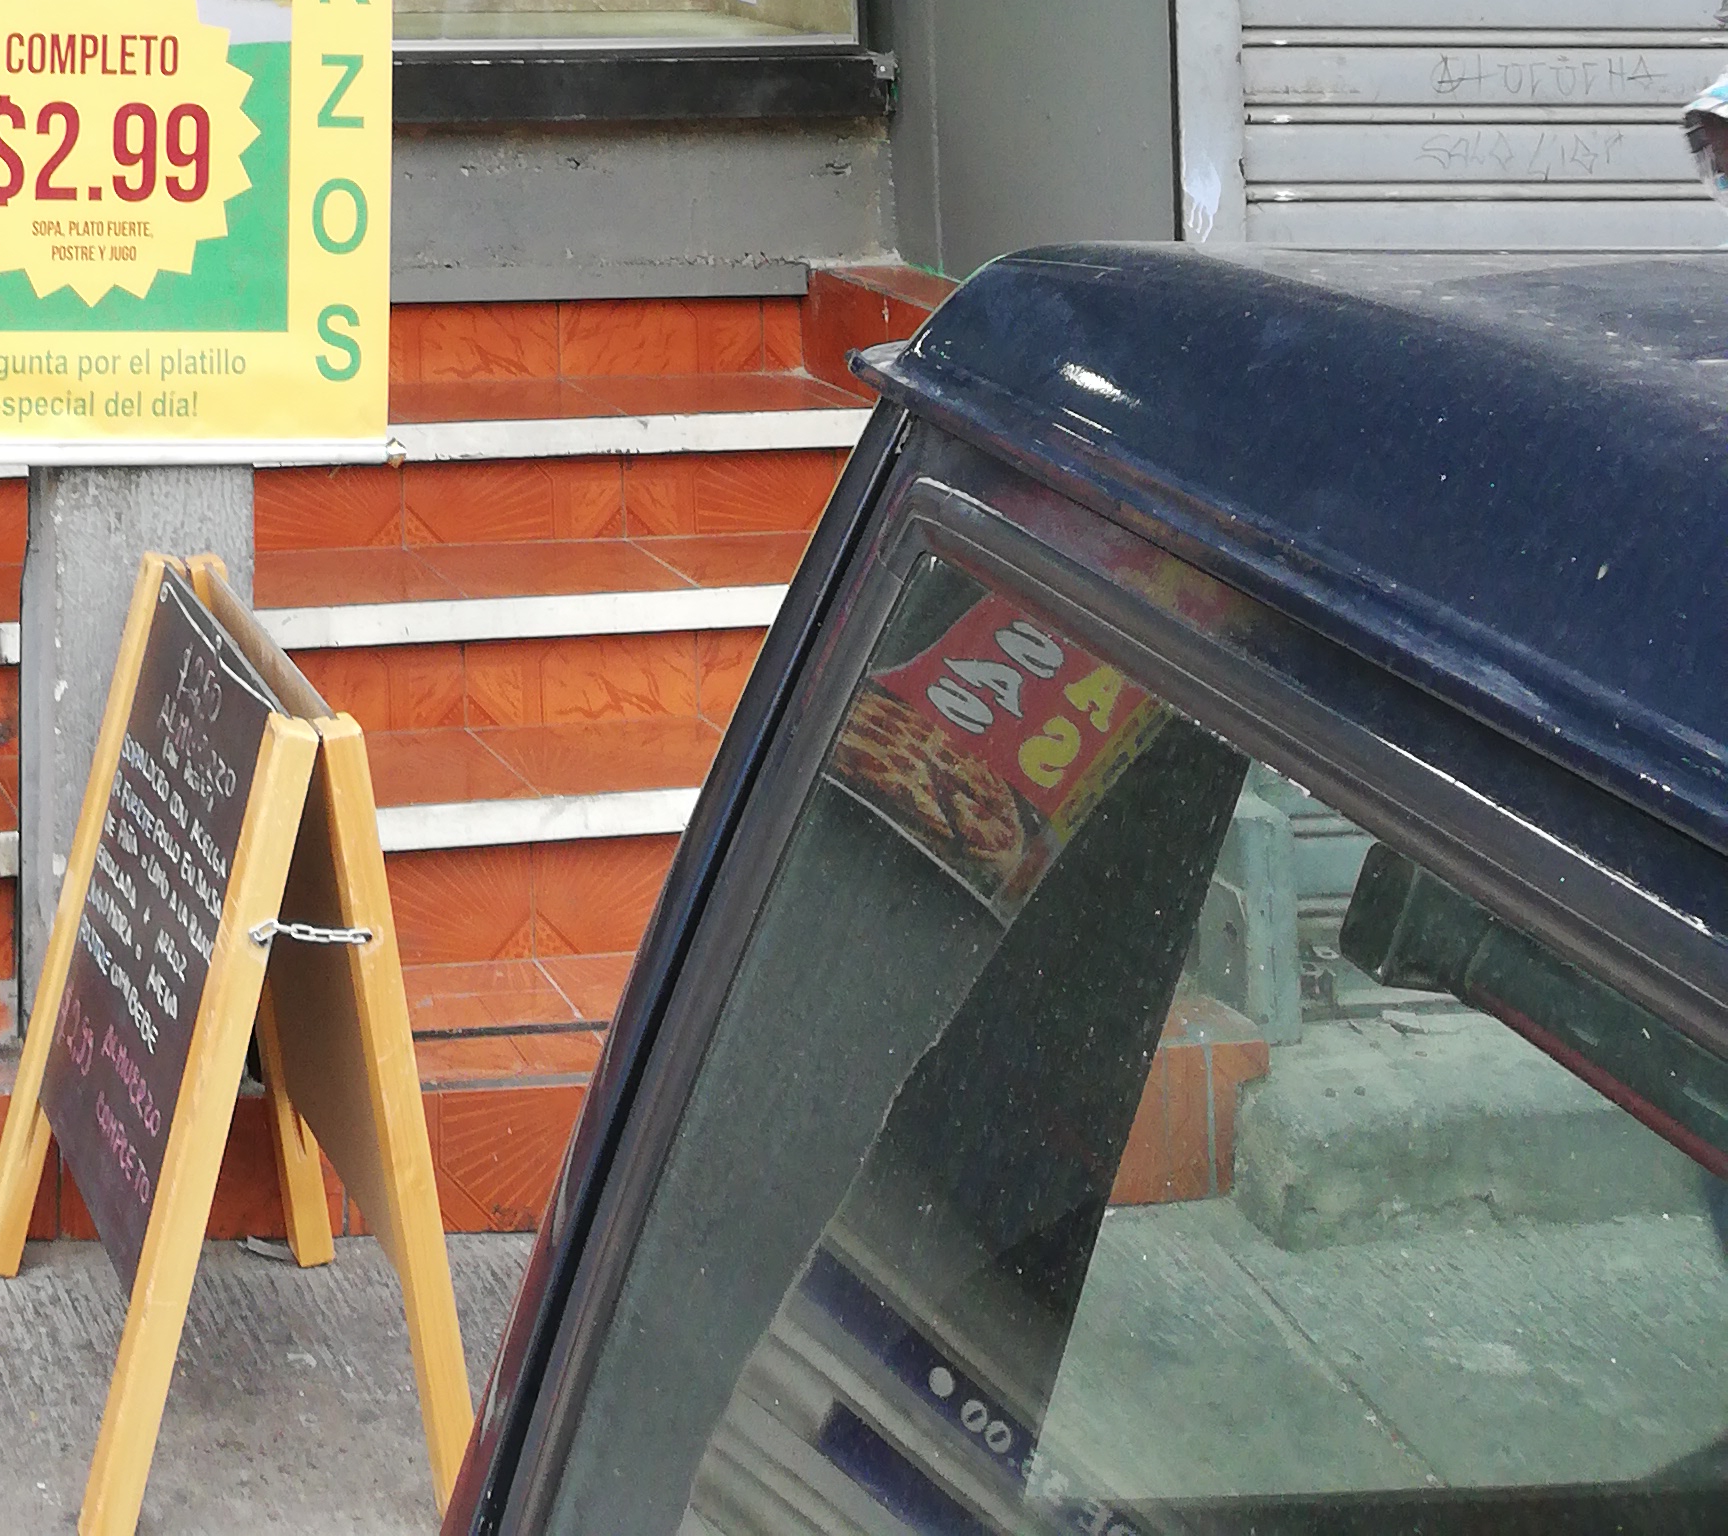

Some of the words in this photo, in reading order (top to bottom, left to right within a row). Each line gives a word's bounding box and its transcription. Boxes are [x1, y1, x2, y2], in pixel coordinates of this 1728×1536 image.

[5, 33, 180, 77] COMPLETO
[31, 219, 65, 239] SOPA,
[68, 219, 104, 238] PLATO
[106, 220, 155, 239] FUERTE,
[50, 244, 96, 262] POSTRE
[98, 244, 107, 261] Y
[109, 244, 138, 262] JUGO
[76, 356, 122, 377] por
[129, 348, 152, 377] el
[159, 348, 248, 378] platillo
[104, 391, 143, 417] del
[150, 391, 199, 417] día!
